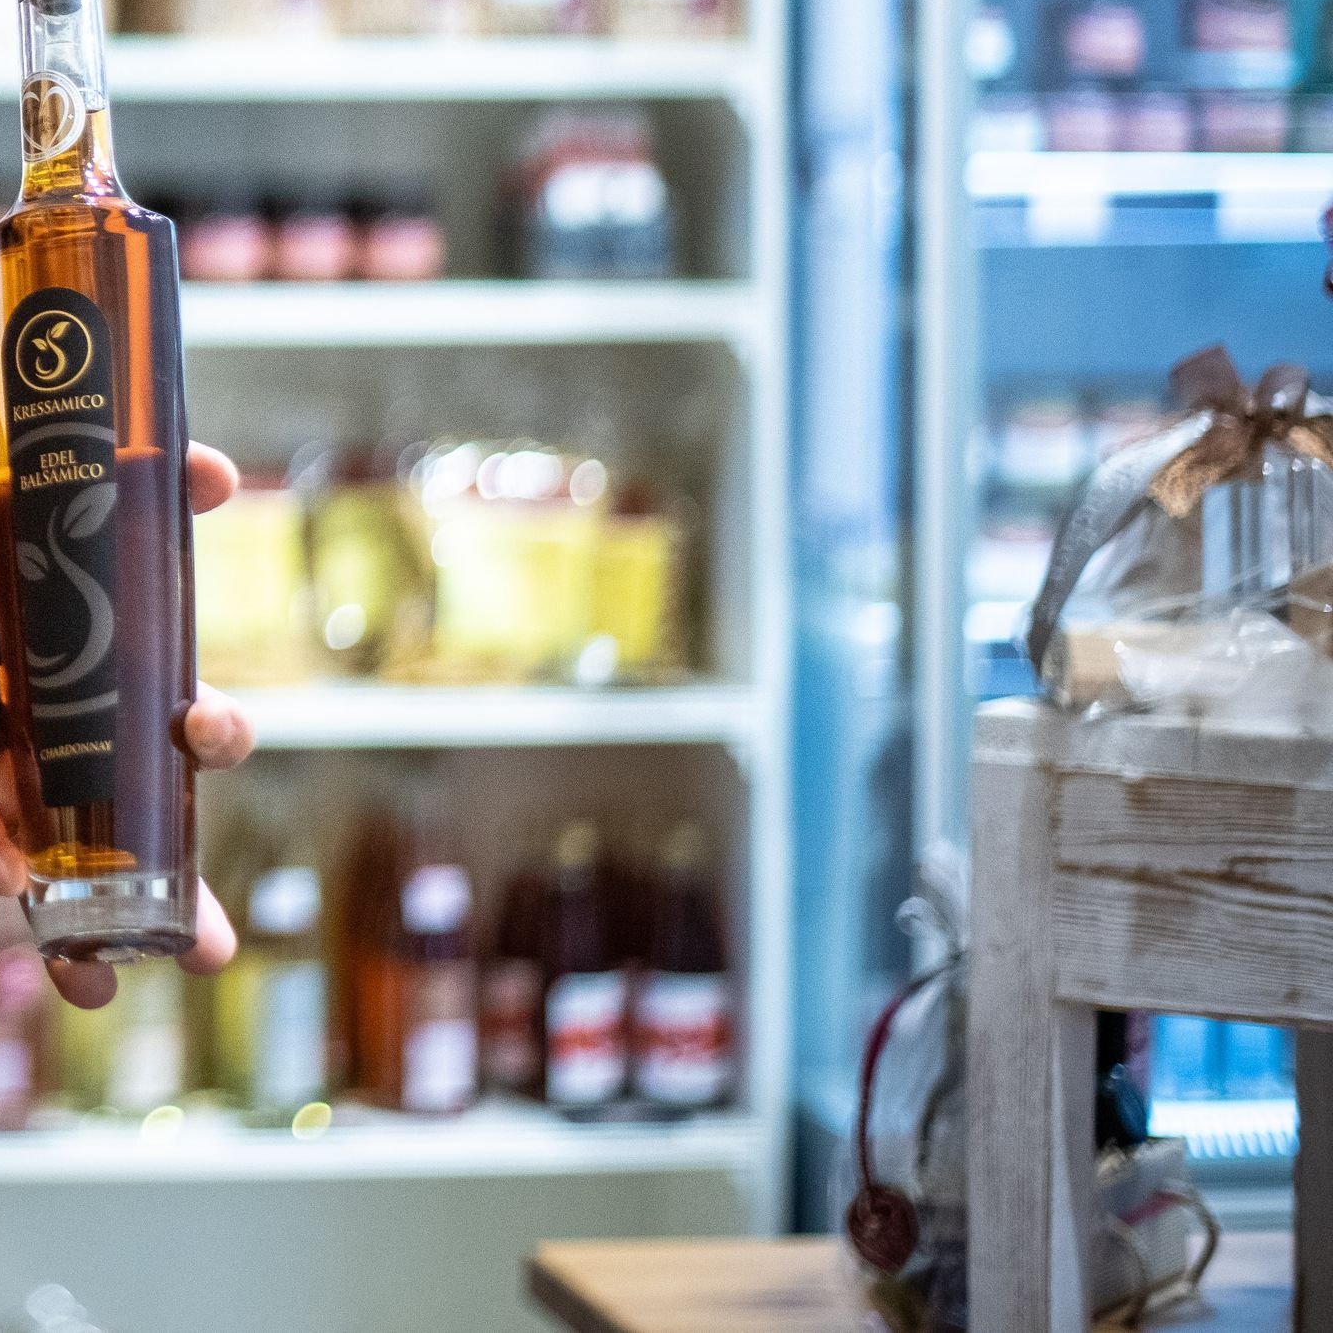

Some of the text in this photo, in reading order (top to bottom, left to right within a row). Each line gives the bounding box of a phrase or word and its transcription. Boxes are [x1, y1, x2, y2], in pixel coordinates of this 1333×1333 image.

[13, 394, 104, 422] KRESSAMICO
[40, 449, 76, 469] EDEL
[20, 463, 103, 491] BALSAMICO
[40, 740, 112, 761] CHARDONNAY
